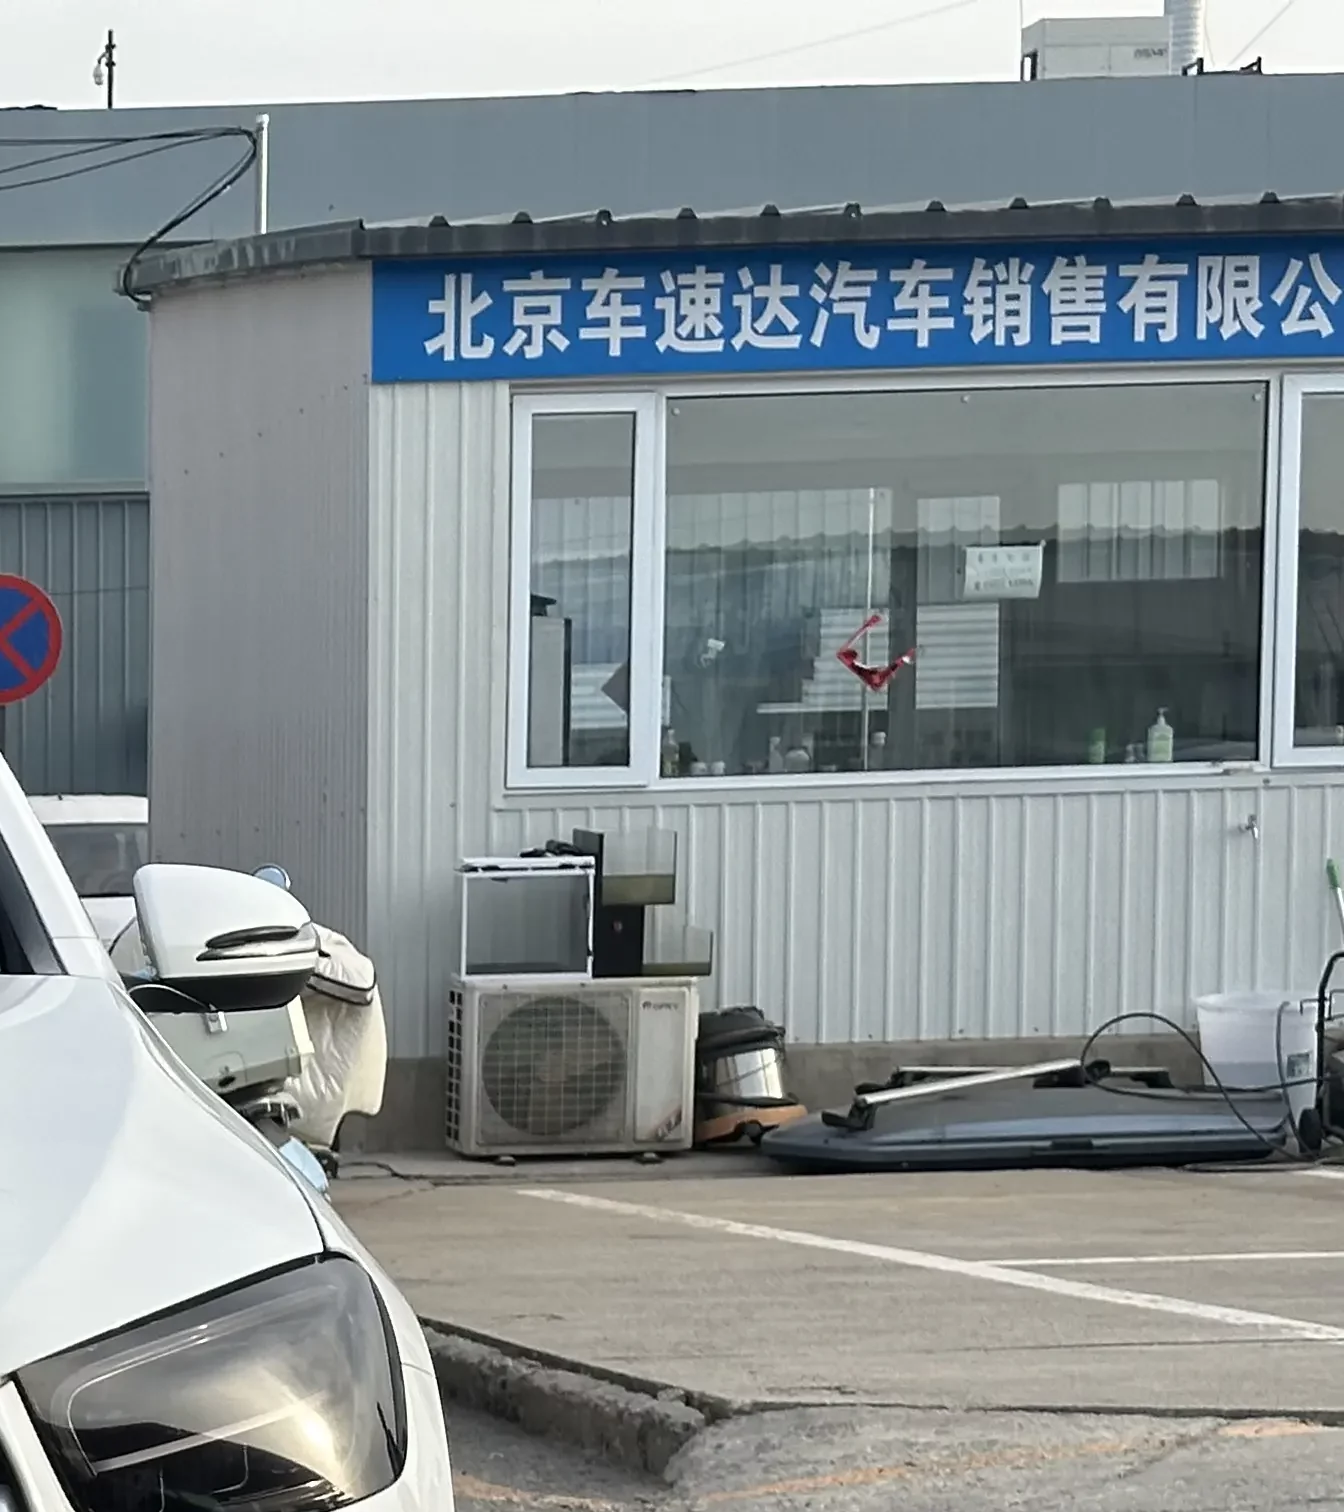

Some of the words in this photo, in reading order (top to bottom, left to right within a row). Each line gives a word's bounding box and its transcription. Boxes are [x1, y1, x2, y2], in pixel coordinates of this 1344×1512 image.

[424, 253, 1343, 360] 北京车速达汽车销售有限公
